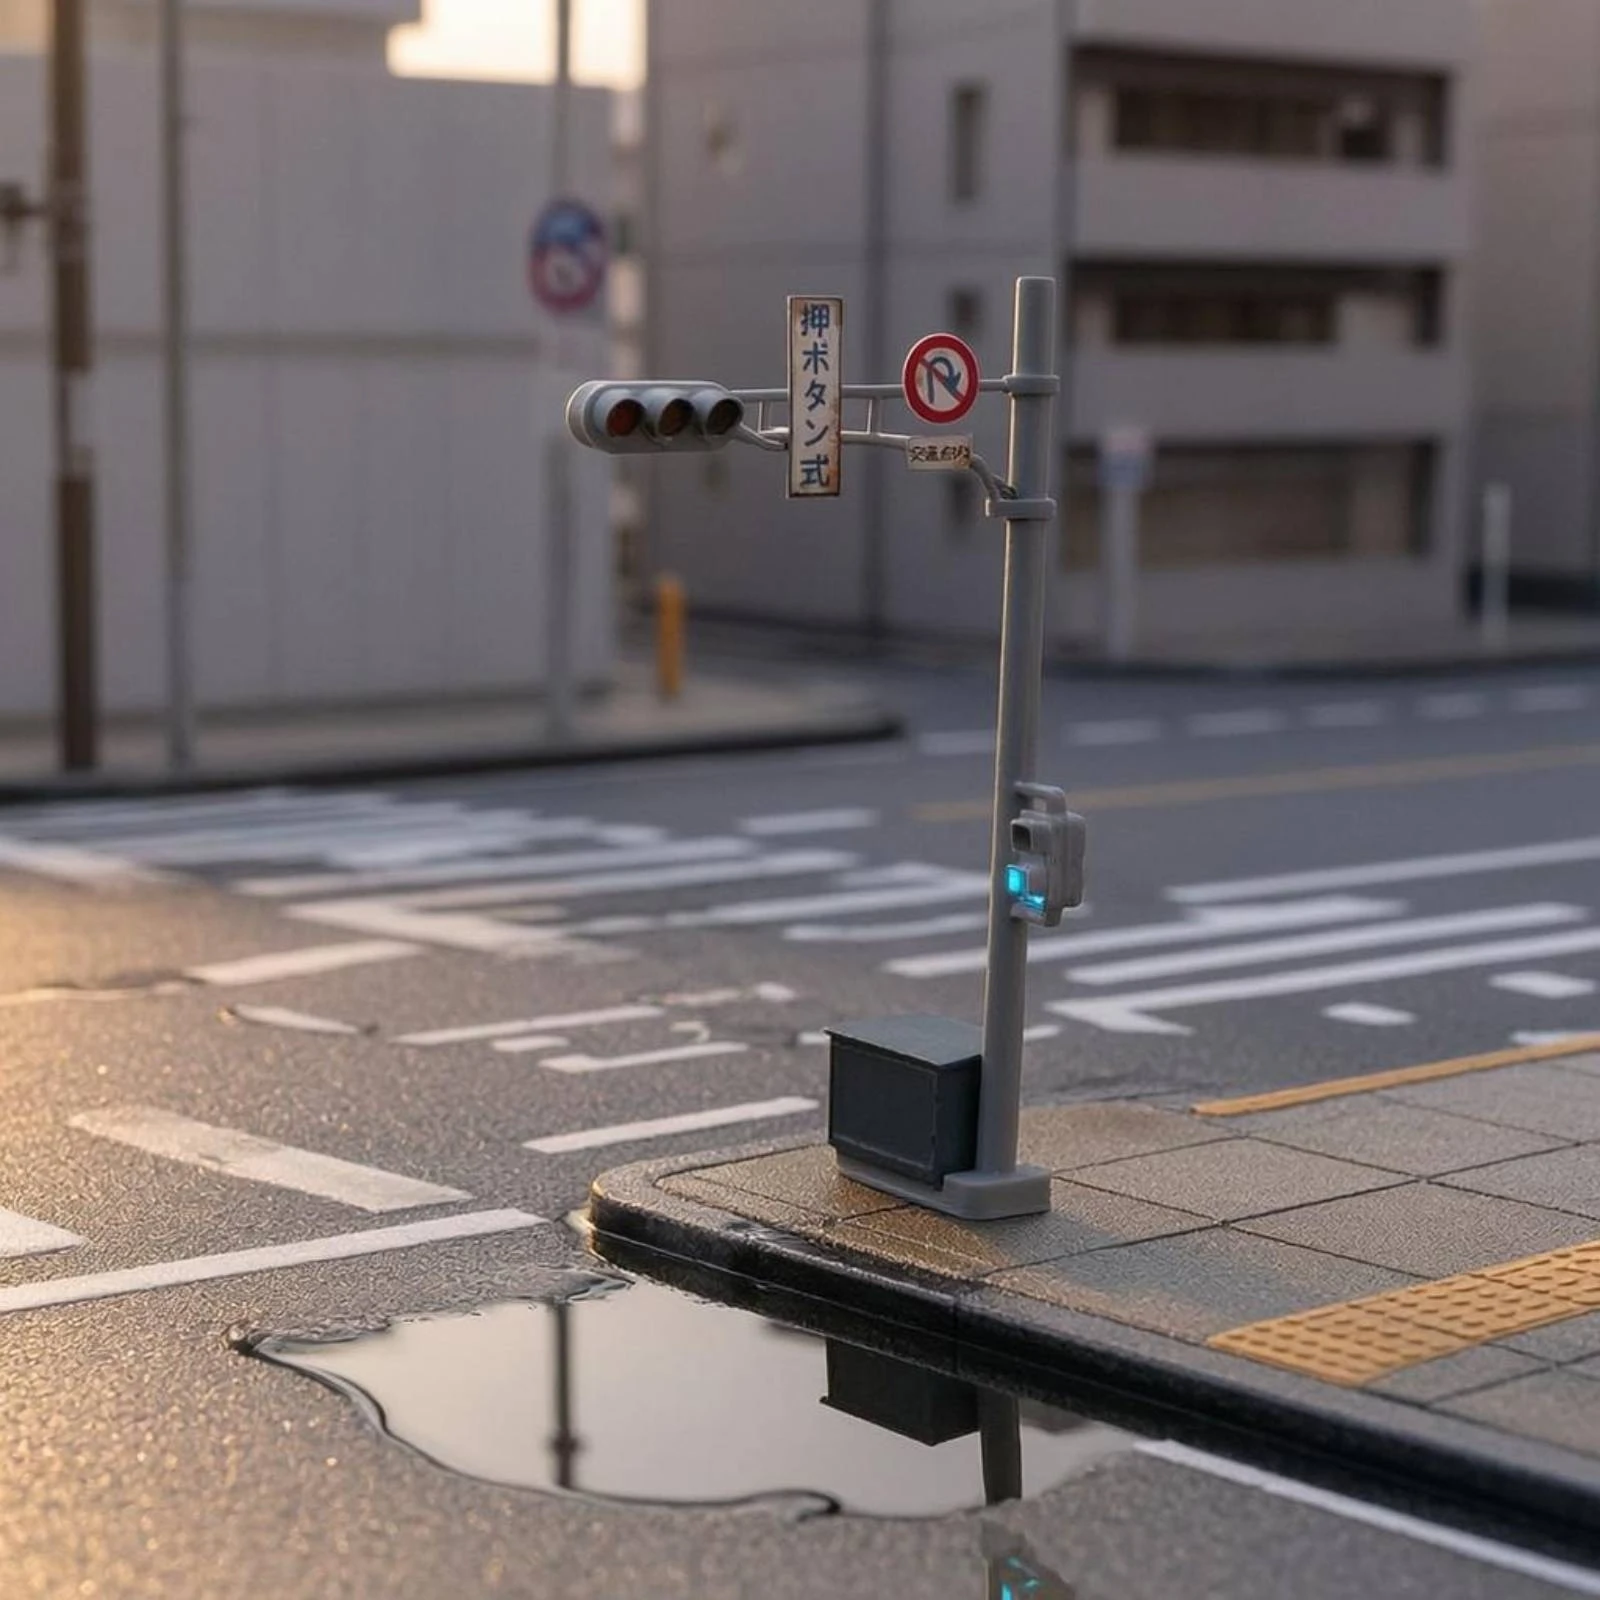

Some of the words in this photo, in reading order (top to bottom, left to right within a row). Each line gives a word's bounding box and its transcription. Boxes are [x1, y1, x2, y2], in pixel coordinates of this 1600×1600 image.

[800, 303, 830, 487] 押ボタン式
